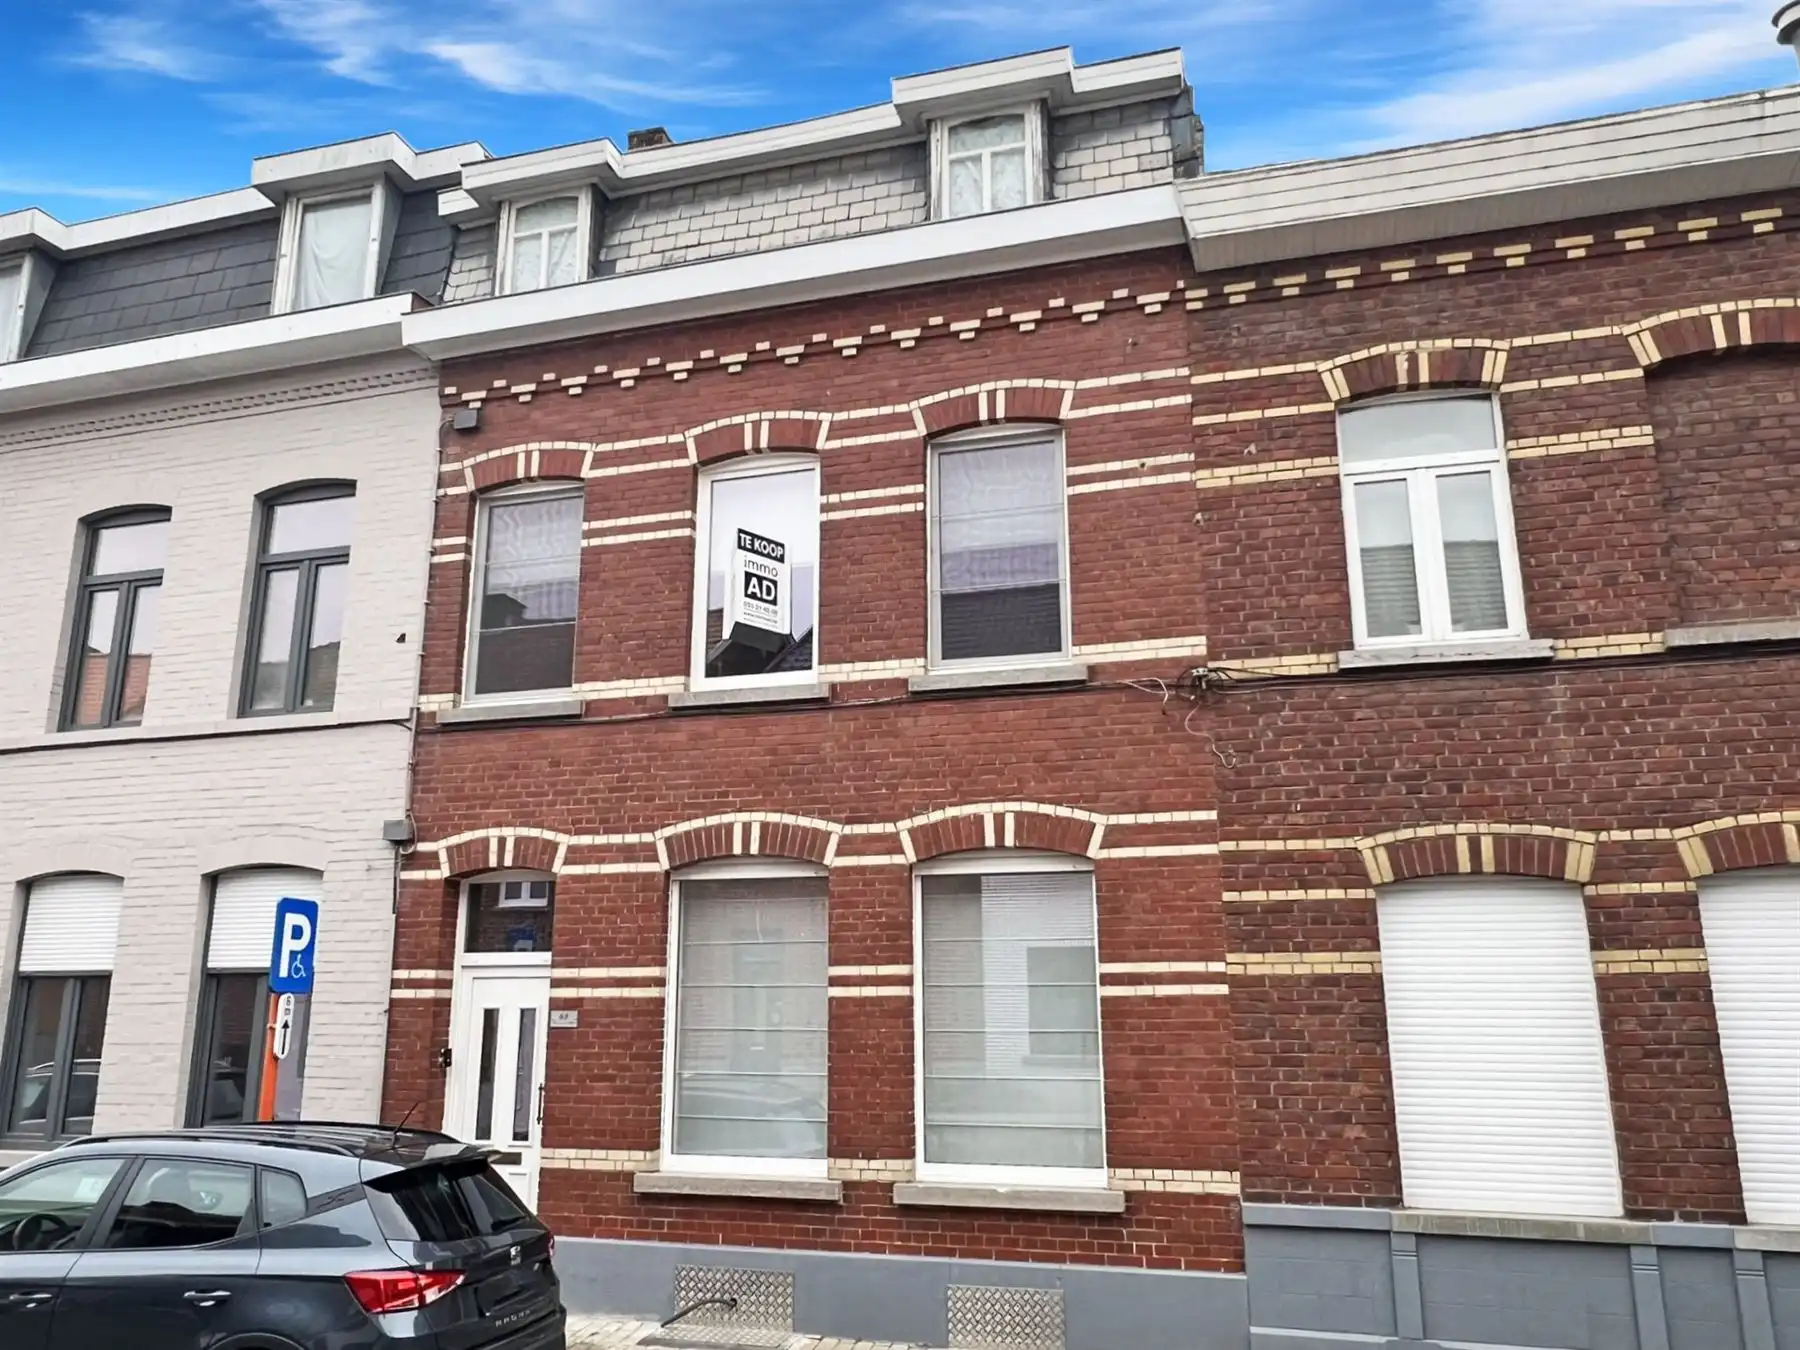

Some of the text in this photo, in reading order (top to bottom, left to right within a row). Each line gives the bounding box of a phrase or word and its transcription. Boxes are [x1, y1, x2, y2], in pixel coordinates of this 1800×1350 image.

[739, 532, 784, 558] TE KOOP
[743, 554, 778, 578] immo
[747, 576, 775, 601] AD
[279, 912, 311, 978] P
